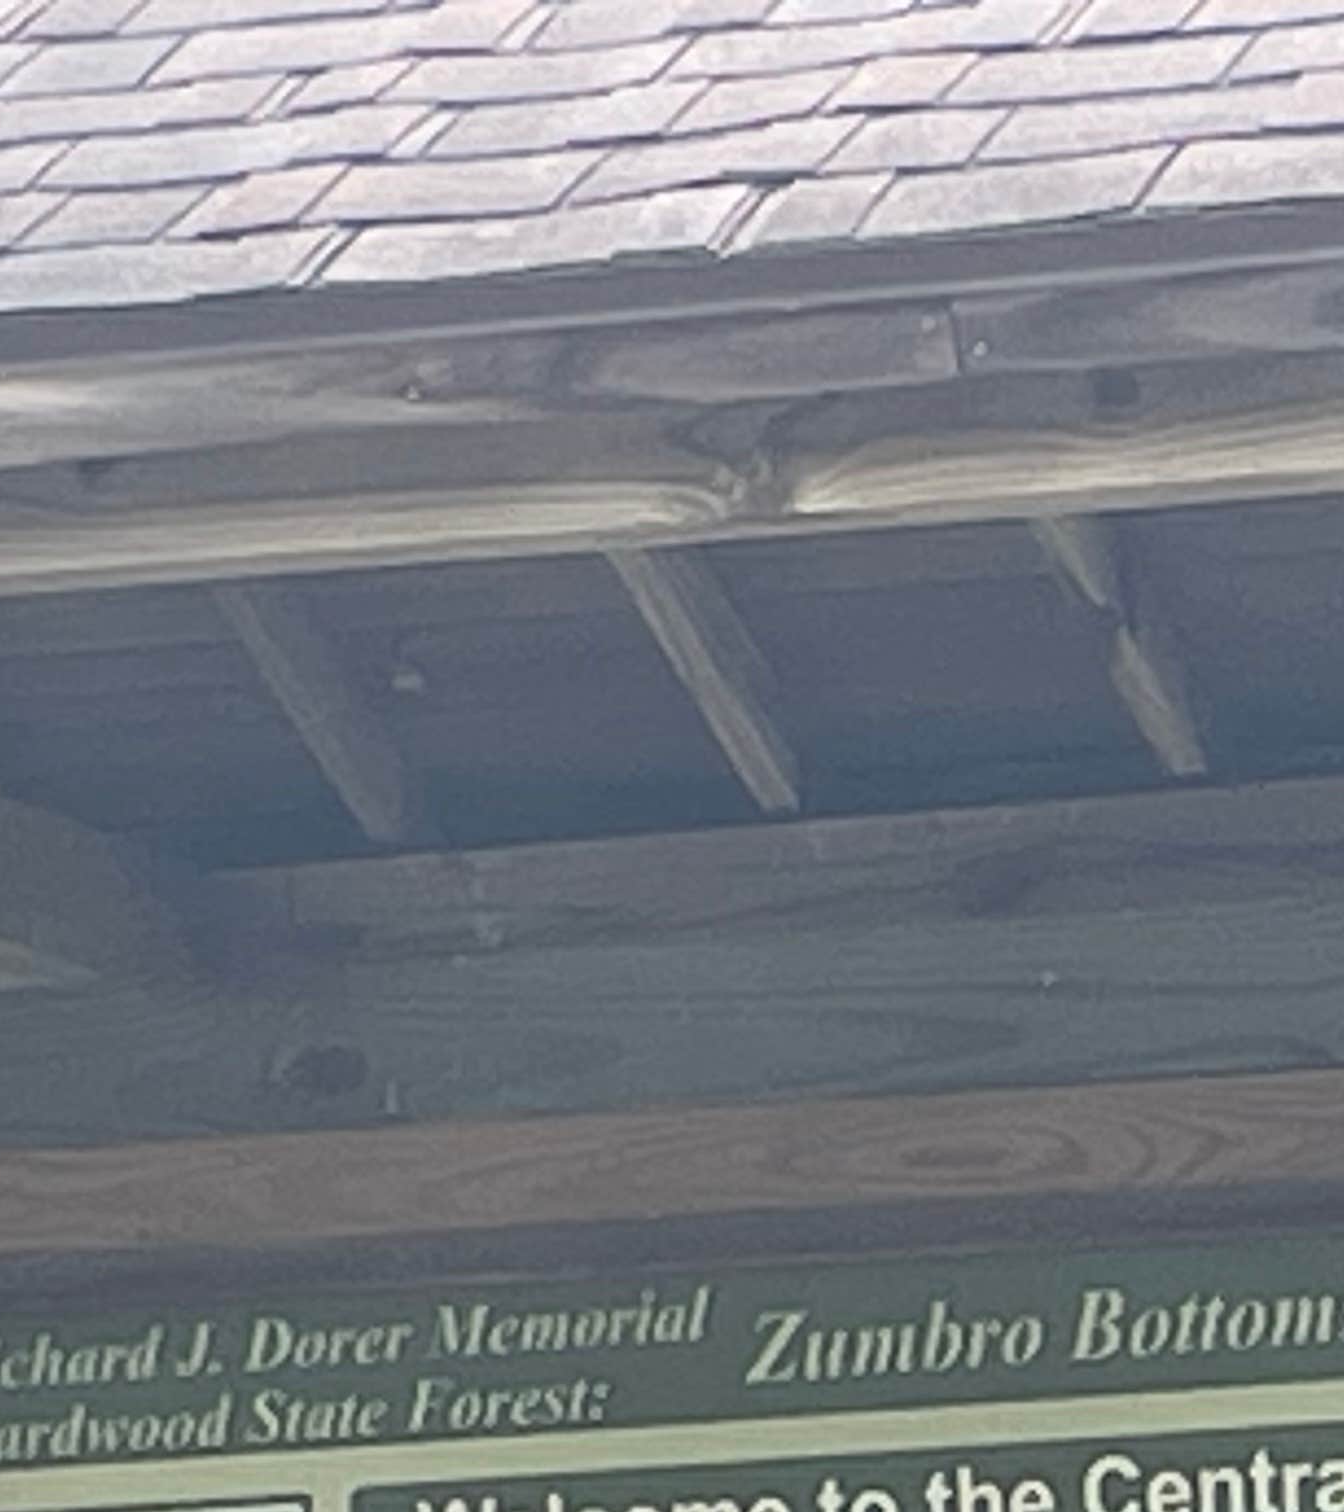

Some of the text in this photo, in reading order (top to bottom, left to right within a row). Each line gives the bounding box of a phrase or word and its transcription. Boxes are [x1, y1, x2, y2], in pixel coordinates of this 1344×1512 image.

[176, 1321, 223, 1378] J.
[244, 1316, 413, 1372] Dorer
[426, 1285, 709, 1359] Memorial
[745, 1300, 1042, 1386] Zumbro
[245, 1388, 389, 1444] State
[408, 1376, 610, 1433] Forest:
